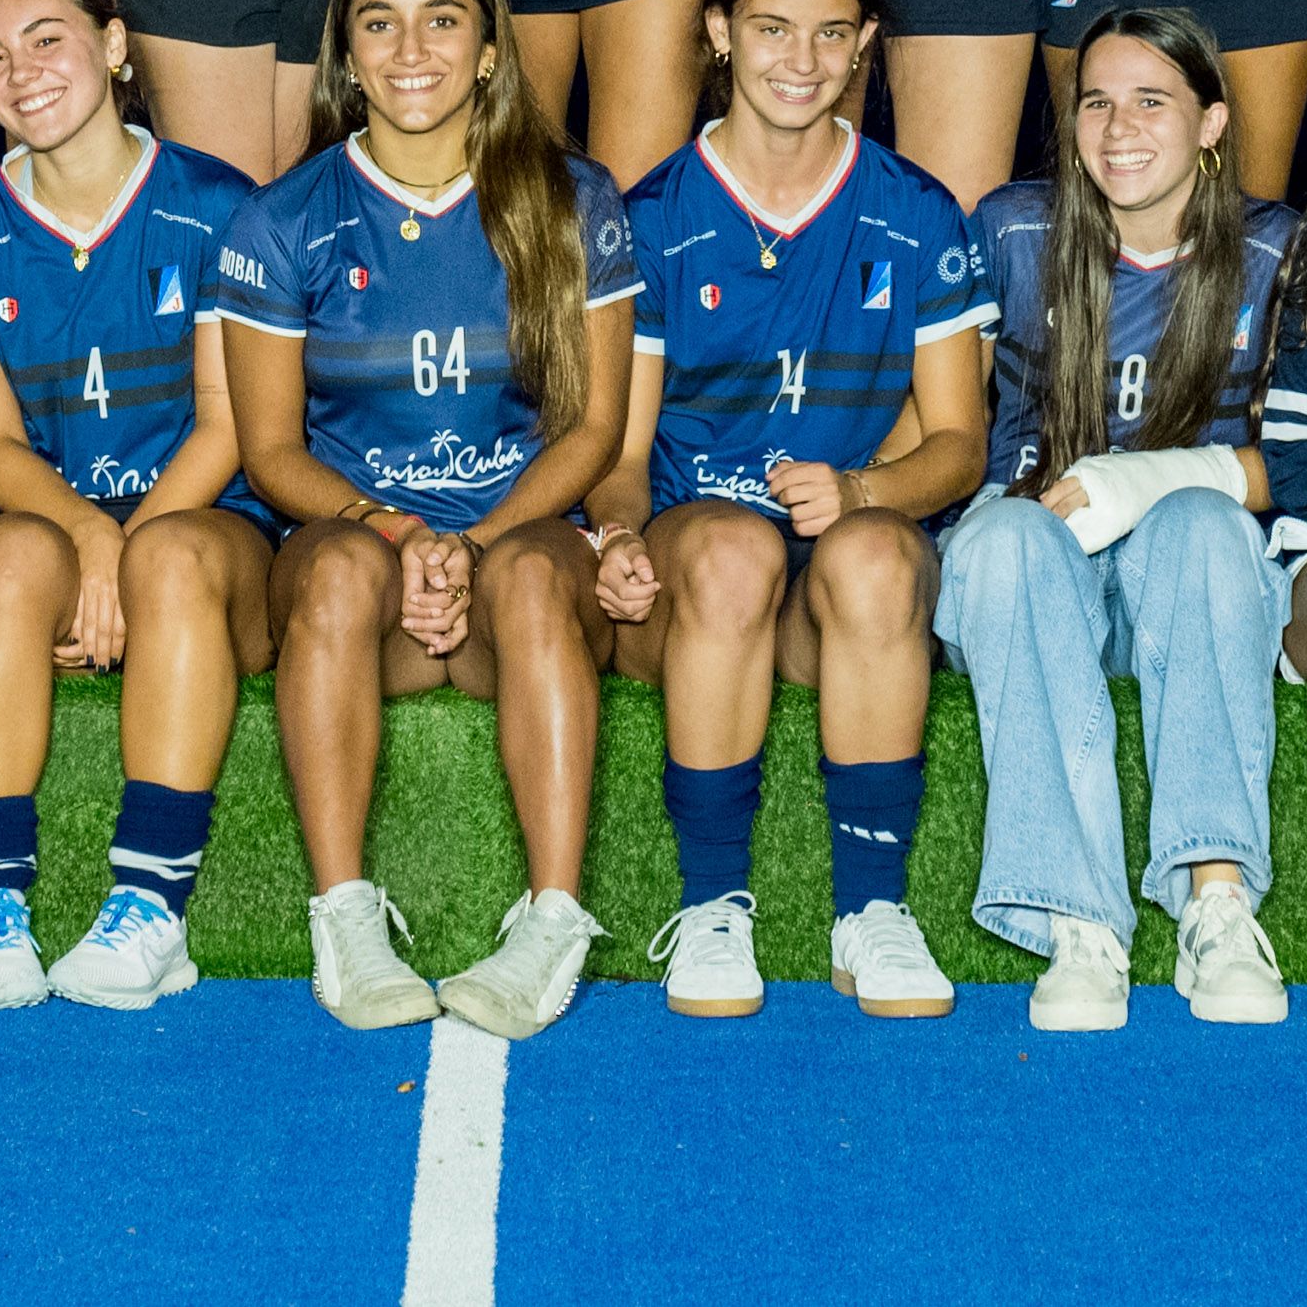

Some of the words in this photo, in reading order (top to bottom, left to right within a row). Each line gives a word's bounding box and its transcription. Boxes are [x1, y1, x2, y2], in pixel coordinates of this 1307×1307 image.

[83, 346, 110, 419] 4
[412, 326, 470, 397] 64
[769, 347, 807, 415] 14
[1118, 354, 1147, 420] 8
[365, 447, 453, 483] Enjoy
[454, 437, 524, 479] Cuba
